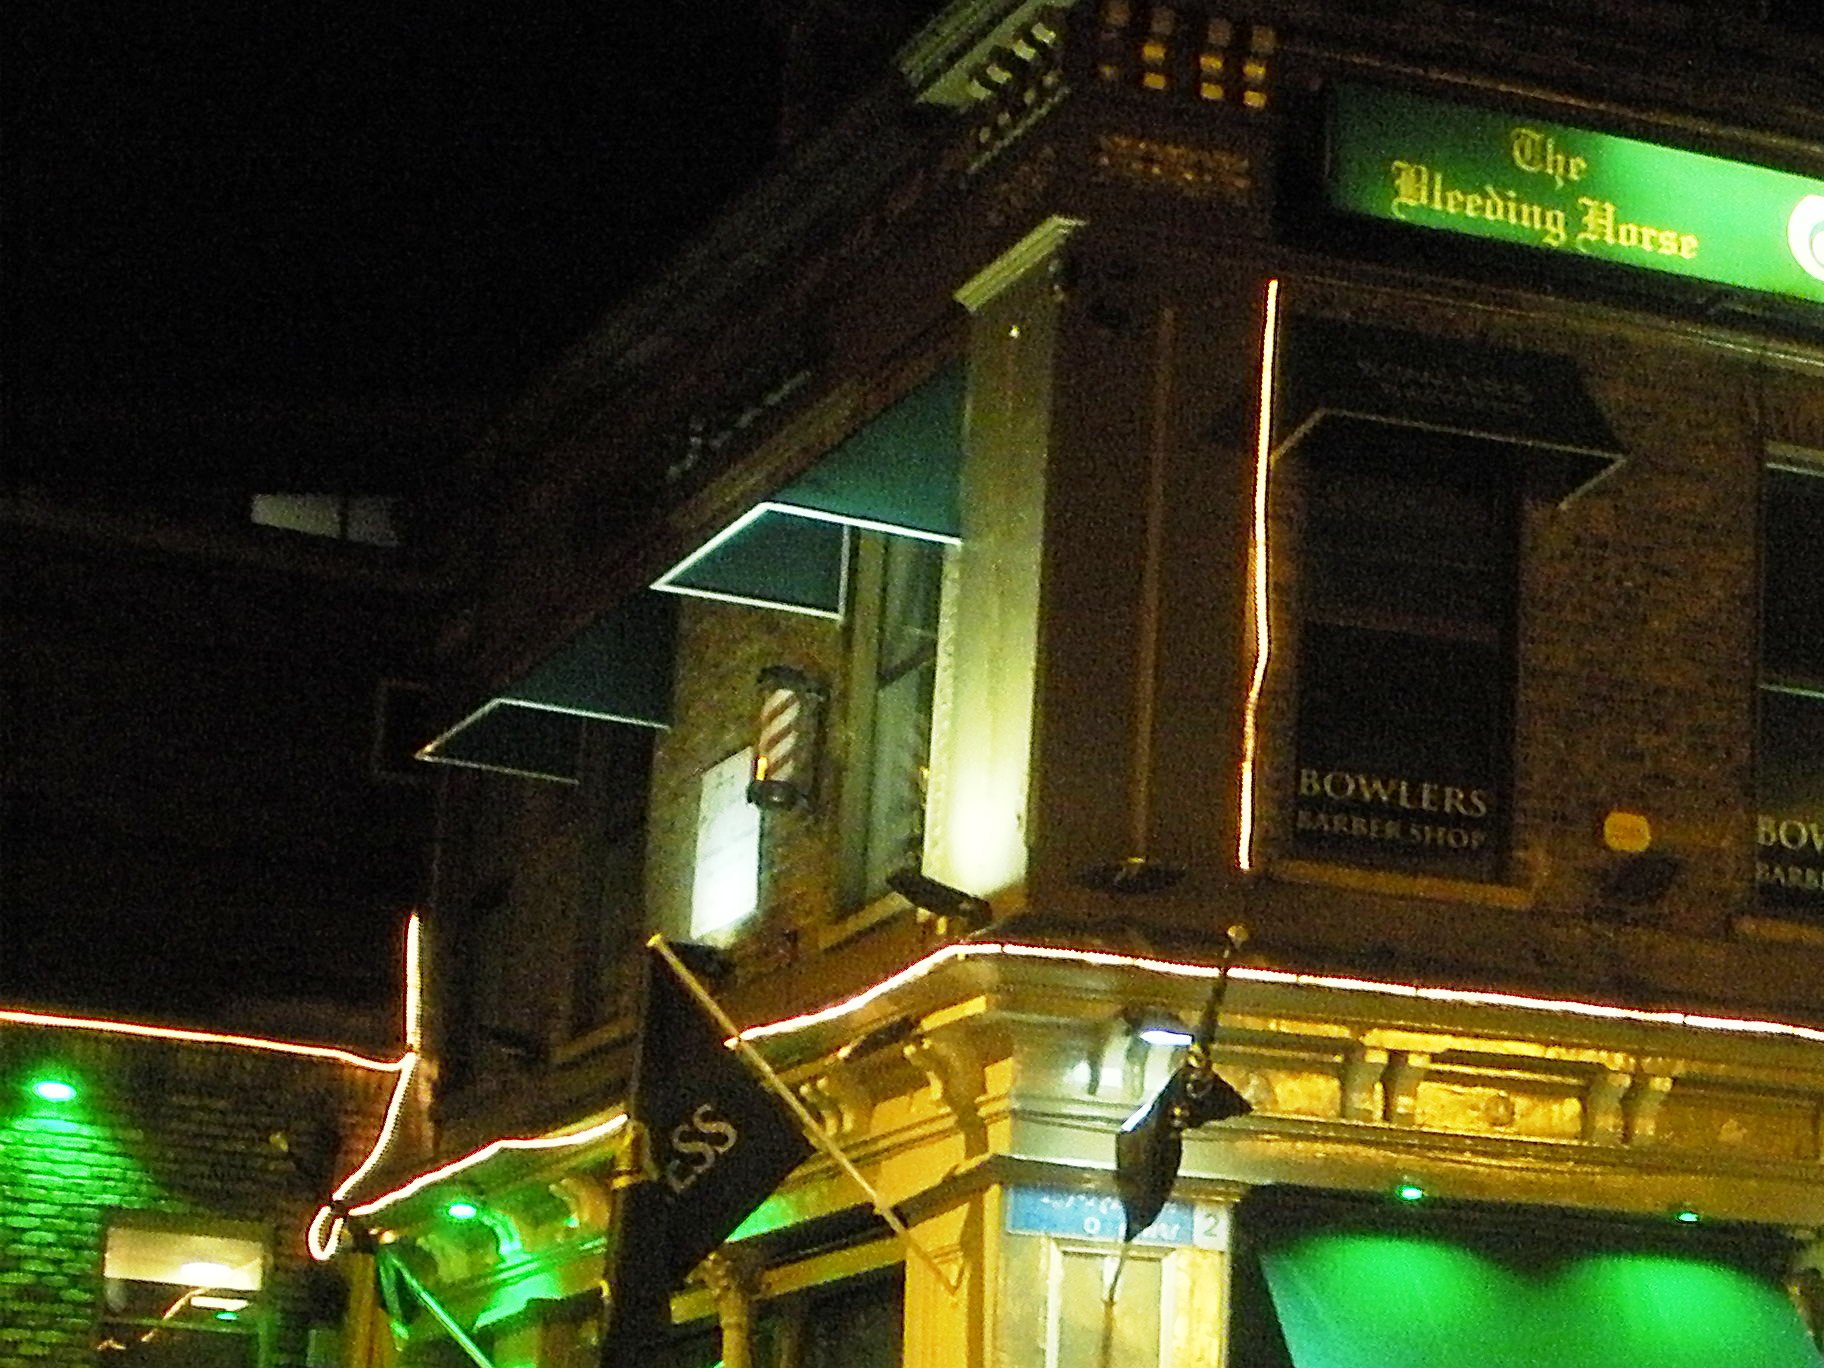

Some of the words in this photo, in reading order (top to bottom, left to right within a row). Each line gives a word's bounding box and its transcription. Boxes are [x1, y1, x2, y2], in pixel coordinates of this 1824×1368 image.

[1510, 127, 1588, 190] The
[1390, 159, 1567, 248] Bleeding
[1575, 196, 1700, 260] Horse
[1299, 767, 1488, 818] BOWLERS
[1203, 1213, 1220, 1238] 2
